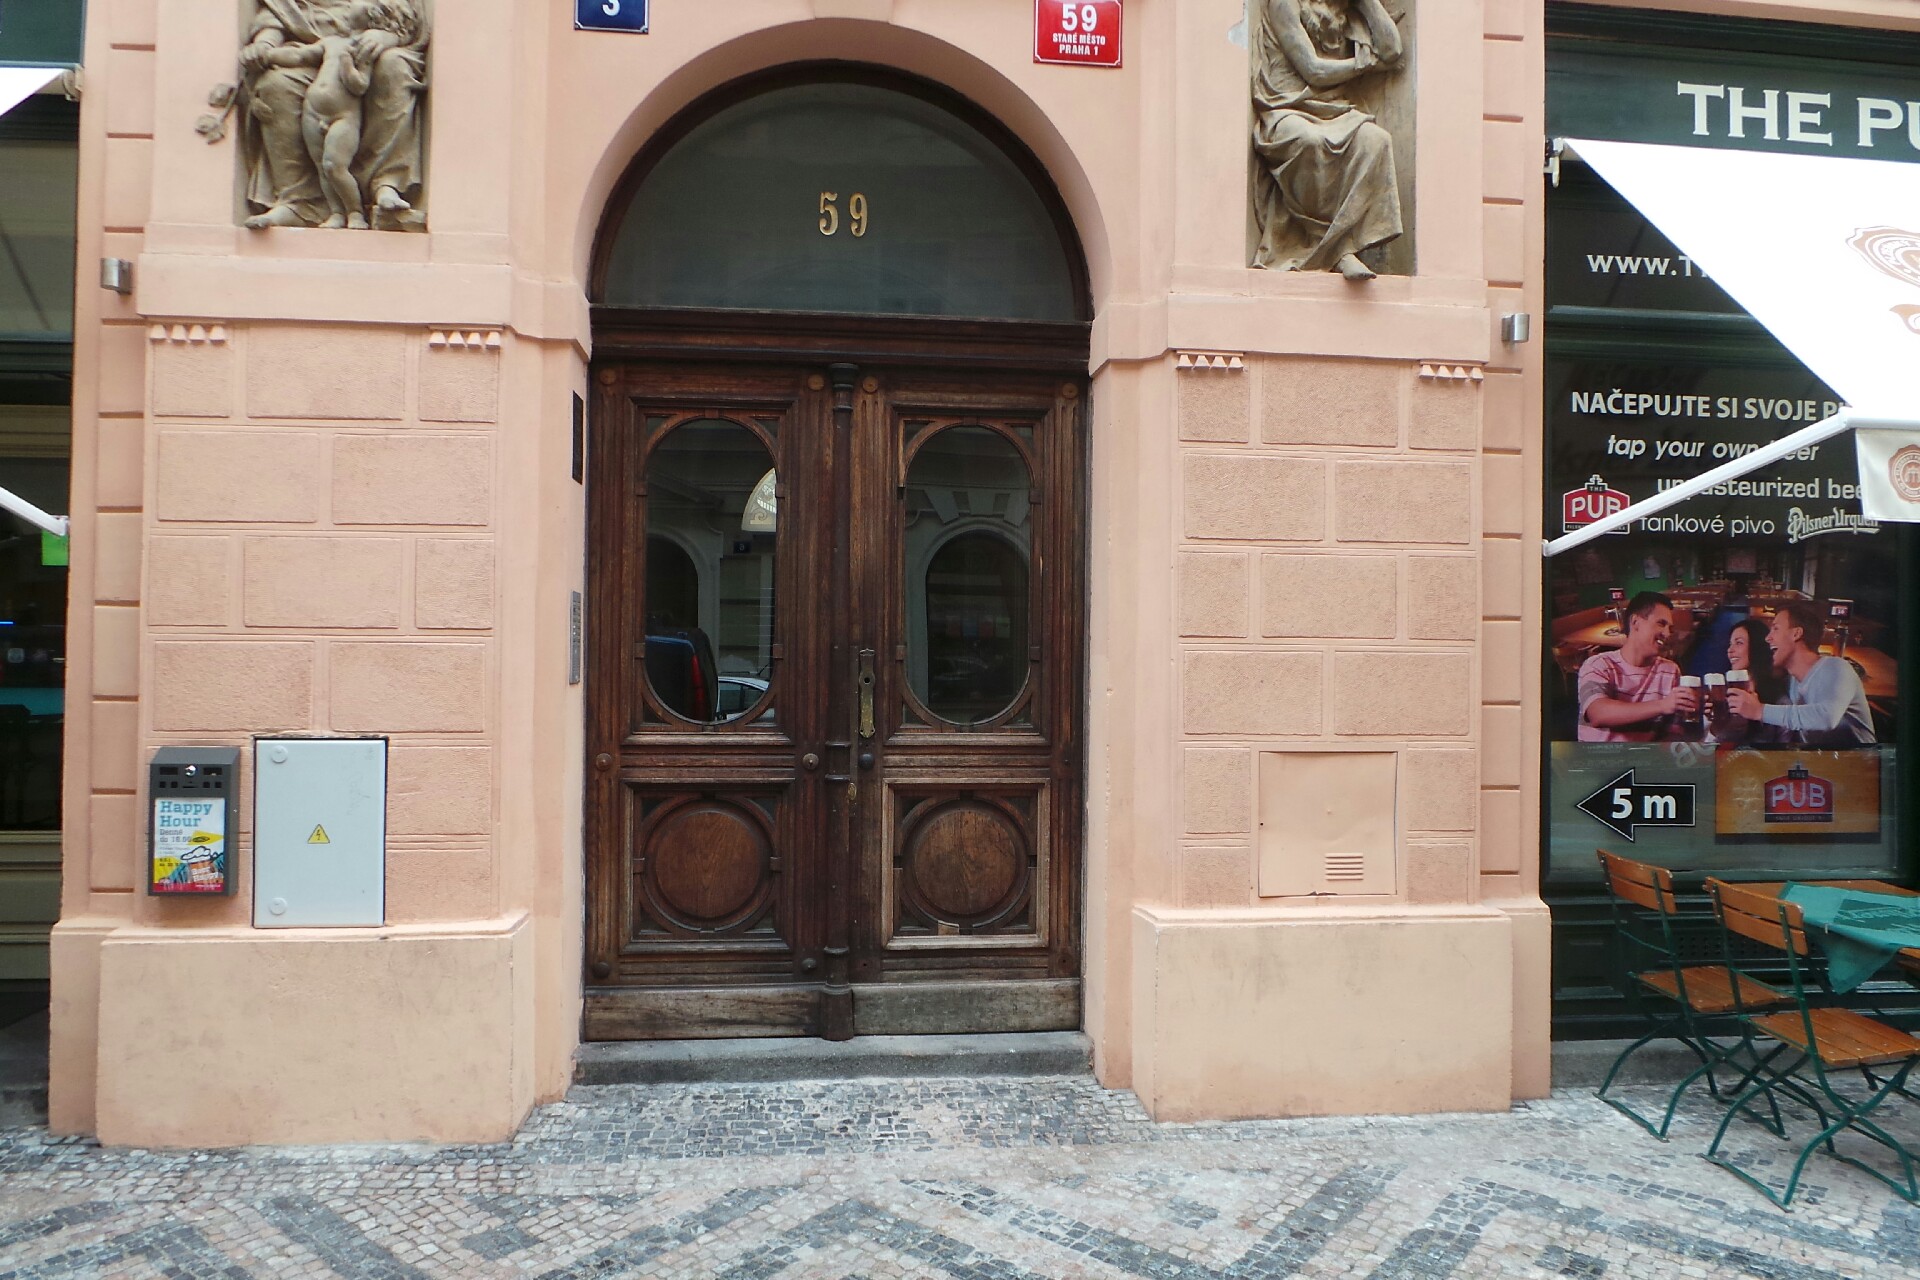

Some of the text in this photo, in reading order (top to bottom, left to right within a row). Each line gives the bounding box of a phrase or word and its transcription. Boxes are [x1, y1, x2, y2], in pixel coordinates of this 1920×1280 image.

[1062, 3, 1097, 32] 59
[1052, 32, 1106, 45] STARÉ MĚSTO
[1059, 44, 1099, 55] PRAHA 1
[1677, 80, 1833, 147] THE
[819, 191, 868, 237] 59
[1586, 254, 1709, 278] www.T
[1572, 388, 1711, 417] NAČEPUJTE
[1717, 397, 1738, 419] SI
[1744, 398, 1817, 421] SVOJE
[1607, 434, 1646, 460] tap
[1655, 440, 1705, 460] your
[1657, 477, 1820, 500] usteurized
[1571, 494, 1621, 518] PUB
[1639, 514, 1775, 538] tankové pivo
[1787, 506, 1835, 544] Pilsner
[1611, 788, 1677, 819] 5 m
[1771, 782, 1826, 808] PUB
[160, 801, 213, 815] Happy
[160, 815, 201, 827] Hour
